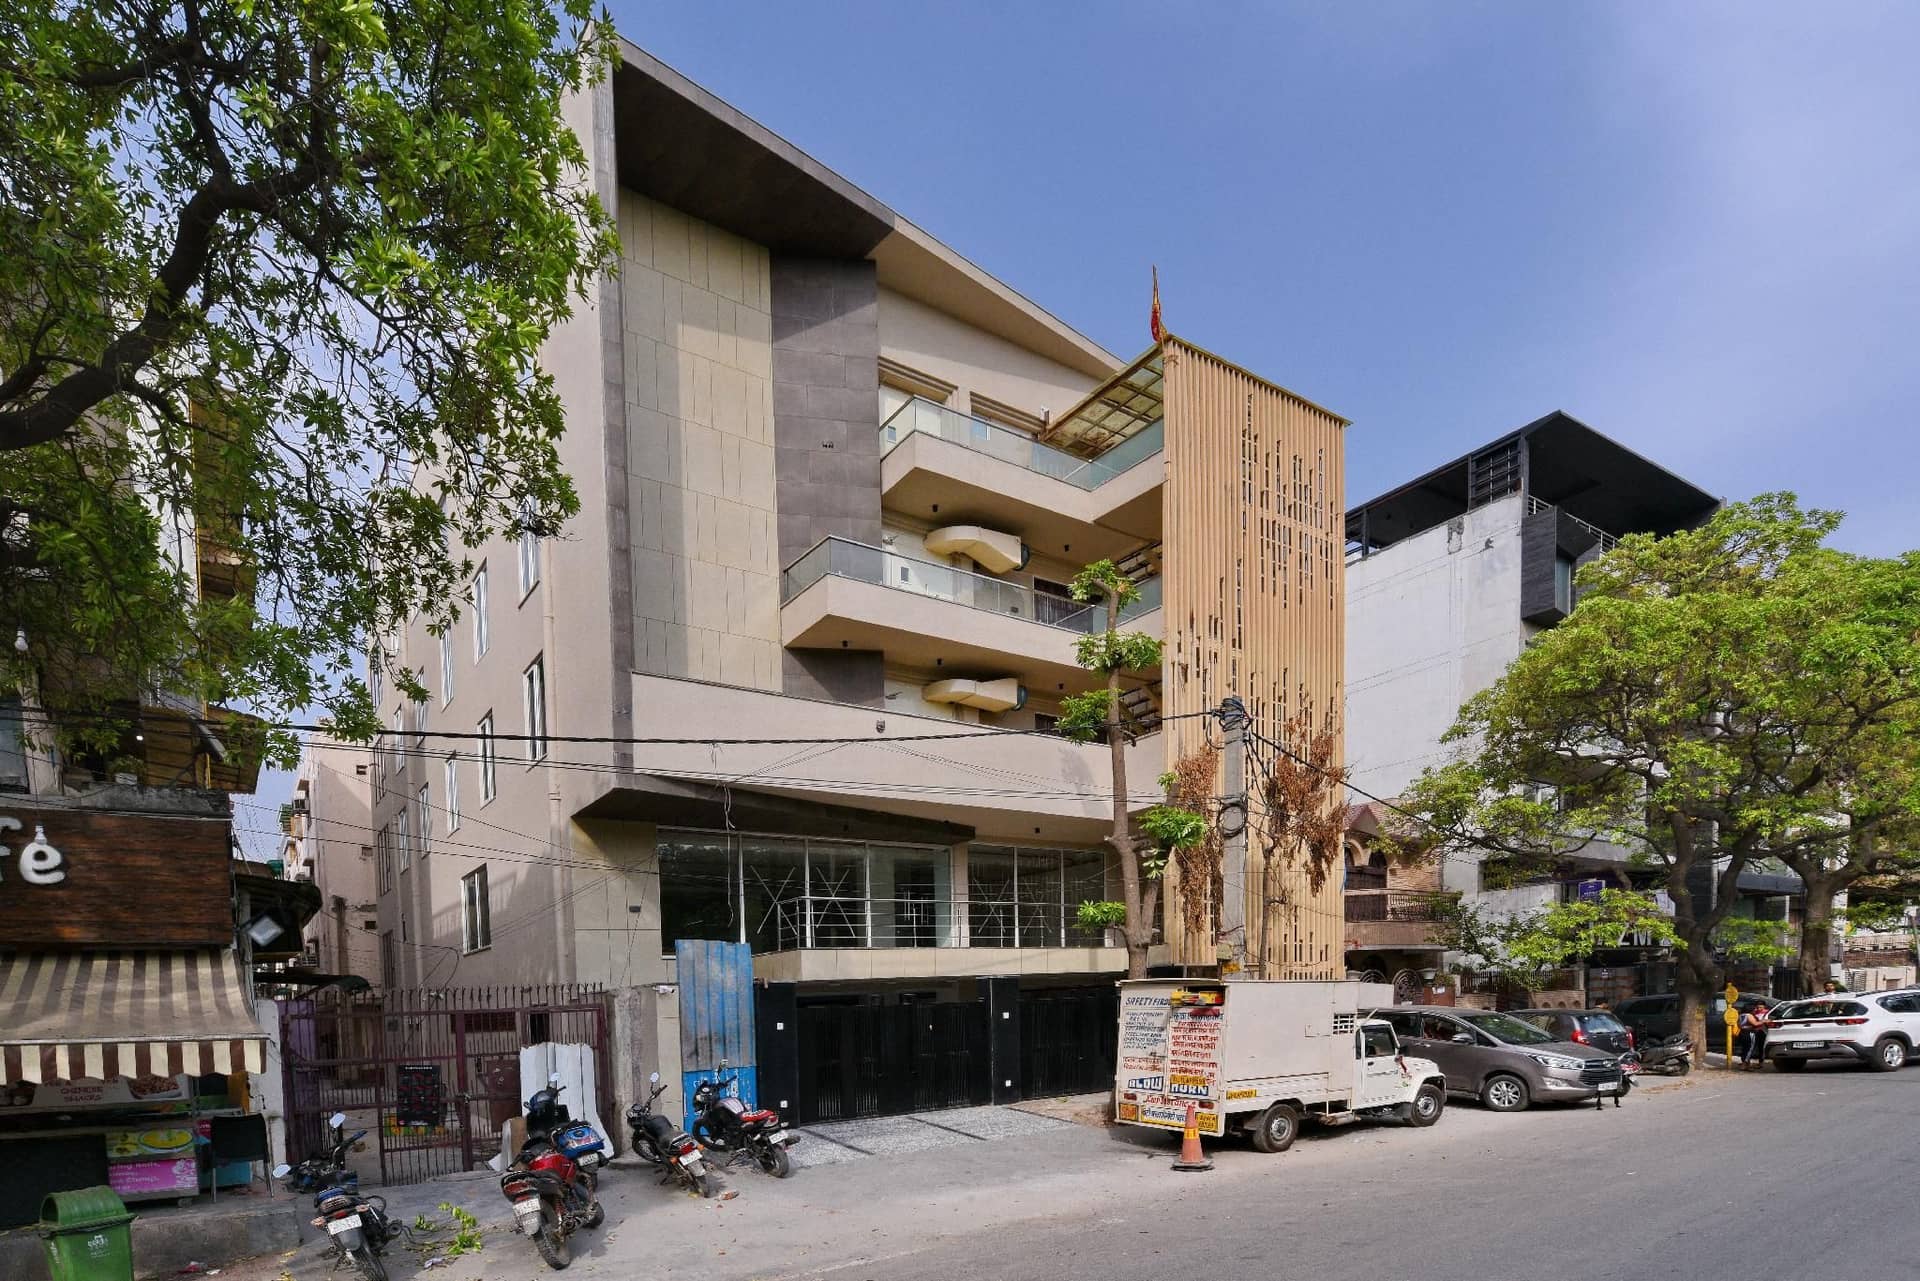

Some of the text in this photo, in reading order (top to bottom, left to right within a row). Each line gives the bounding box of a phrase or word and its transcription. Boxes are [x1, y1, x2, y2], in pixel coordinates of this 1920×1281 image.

[1125, 997, 1171, 1006] SAFETY FIRS
[1128, 1077, 1163, 1090] BLOW
[1171, 1084, 1208, 1096] HORN
